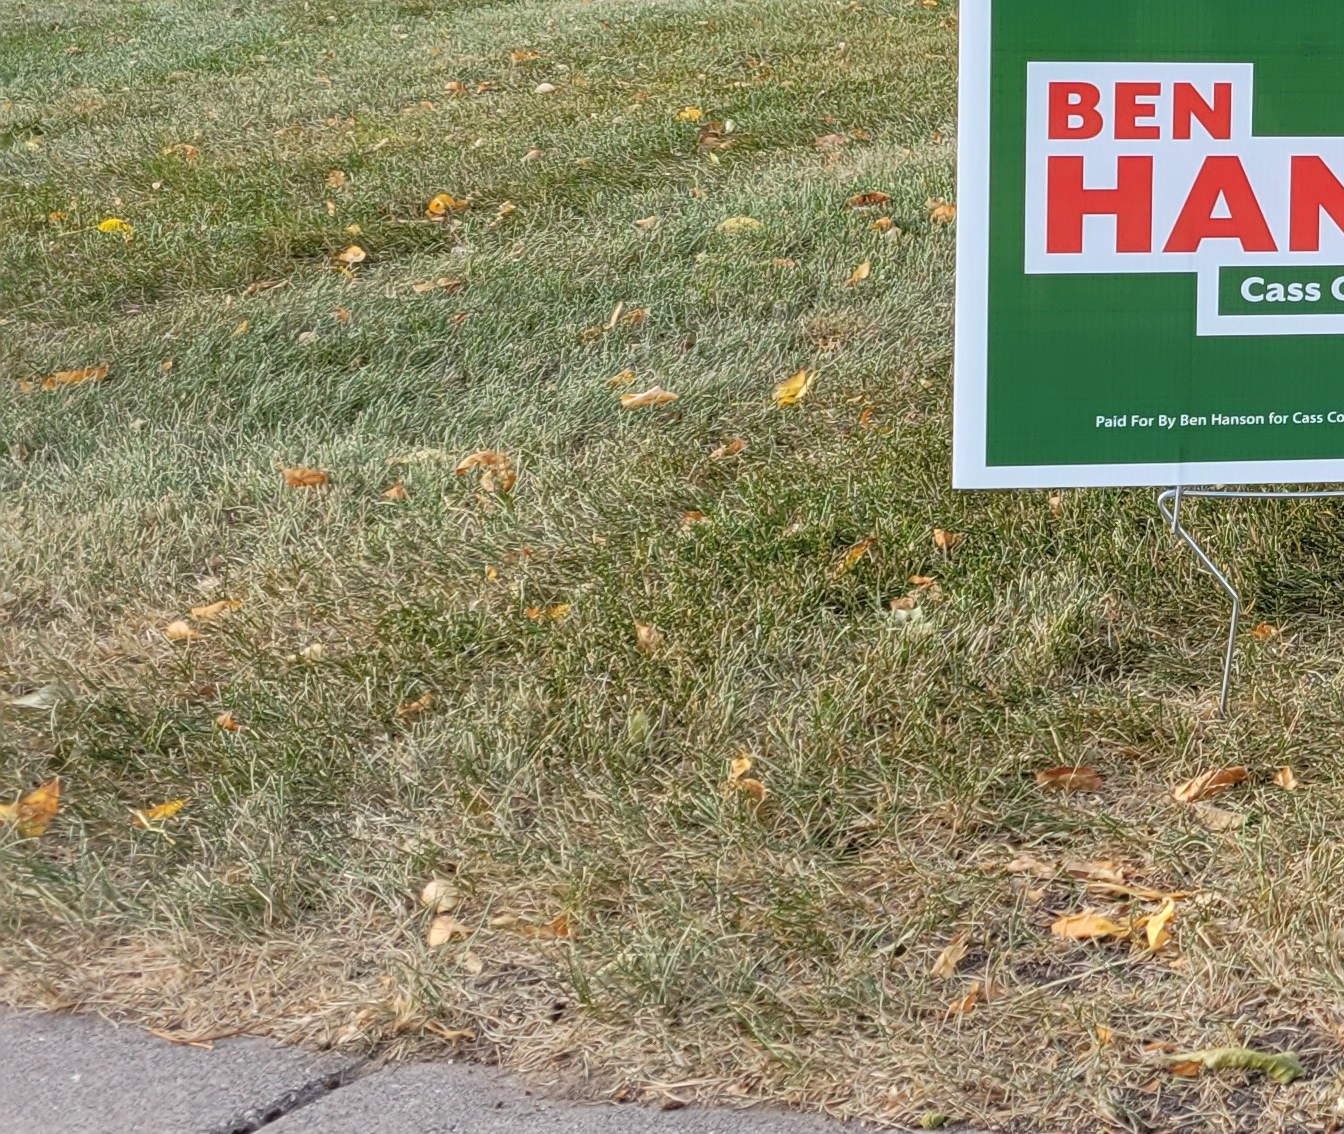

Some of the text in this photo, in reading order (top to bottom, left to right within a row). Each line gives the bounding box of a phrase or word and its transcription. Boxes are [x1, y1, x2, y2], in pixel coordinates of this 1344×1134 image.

[1047, 81, 1233, 140] BEN
[1240, 276, 1322, 303] Cass
[1095, 414, 1127, 427] Paid
[1131, 414, 1155, 427] For
[1158, 414, 1176, 429] By
[1180, 413, 1207, 426] Ben
[1211, 413, 1265, 426] Hanson
[1268, 411, 1289, 424] for
[1292, 411, 1324, 424] Cass
